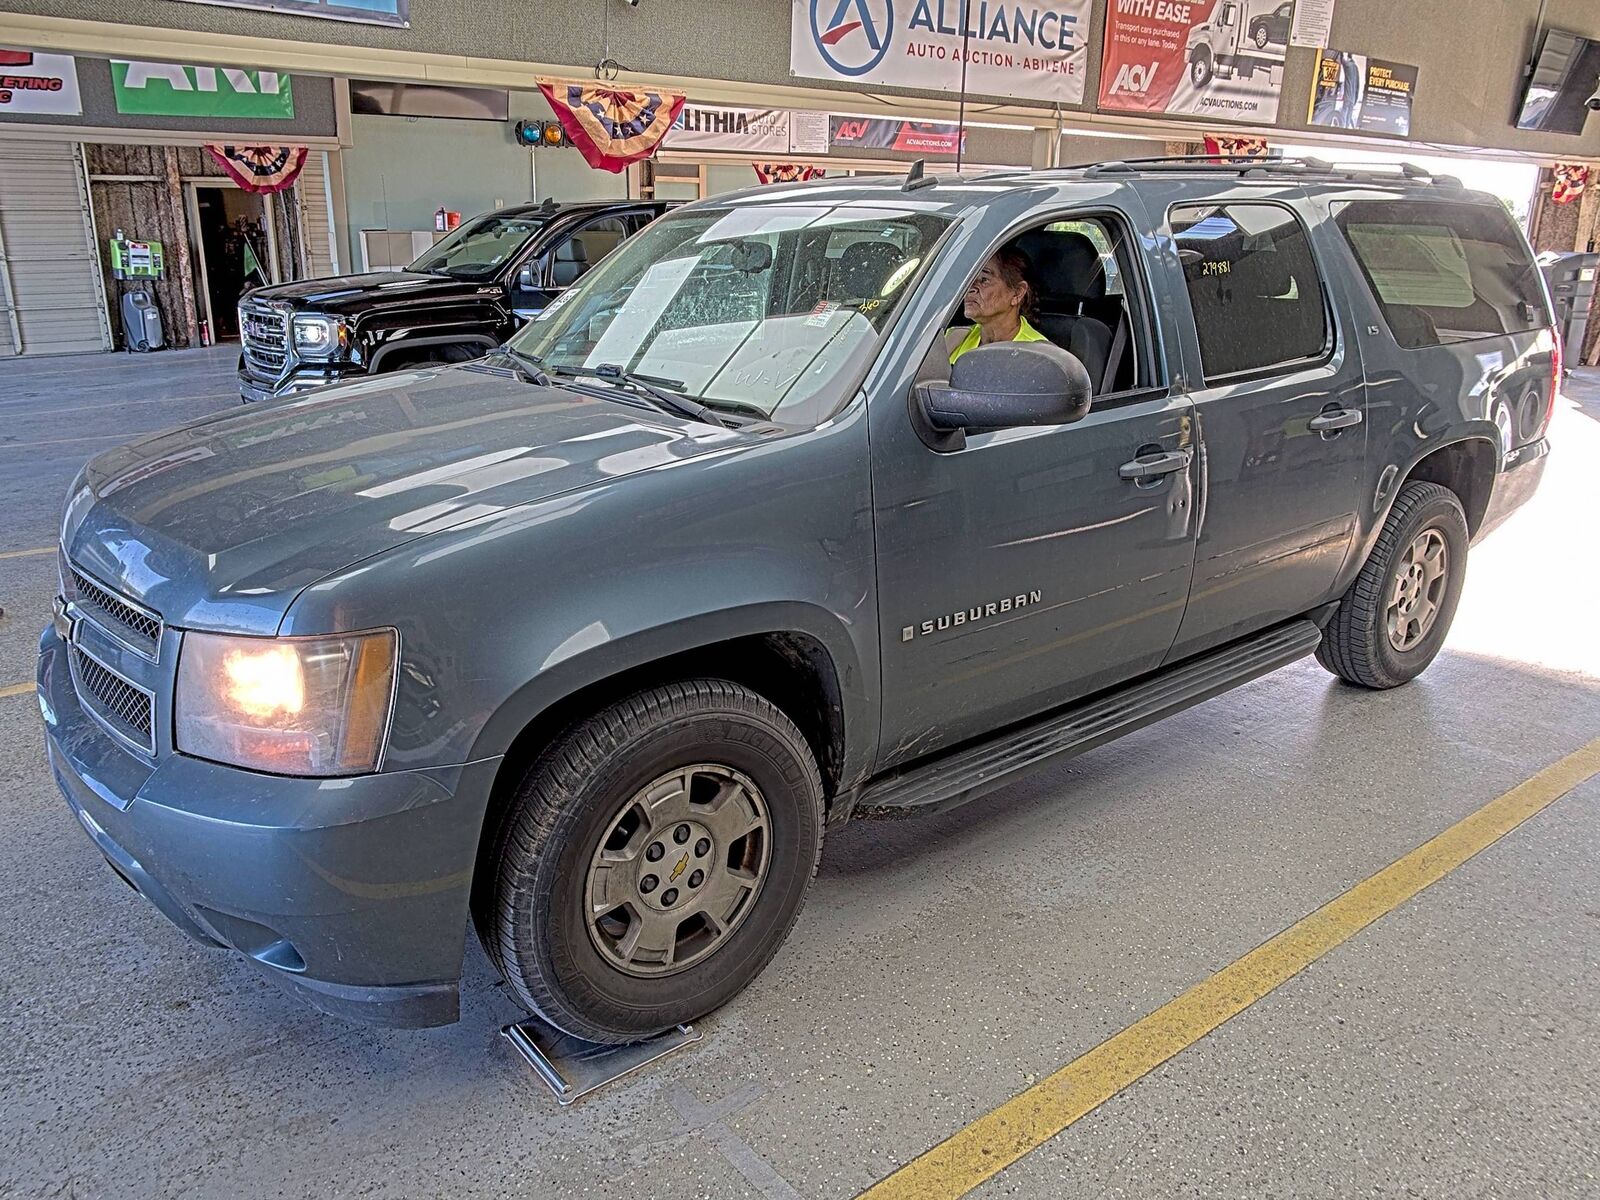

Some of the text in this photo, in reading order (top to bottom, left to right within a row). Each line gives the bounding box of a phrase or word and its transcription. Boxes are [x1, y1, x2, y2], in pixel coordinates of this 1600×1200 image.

[1117, 0, 1191, 24] WITH EASE.
[908, 0, 1078, 51] ALLIANCE
[1115, 20, 1180, 38] Transport cars purchased
[1114, 32, 1119, 40] in
[1120, 34, 1130, 42] this
[1137, 38, 1147, 47] any
[906, 43, 946, 57] AUTO
[952, 49, 1013, 67] AUCTION
[1023, 57, 1075, 75] ABILENE
[1108, 61, 1160, 95] ACV
[1370, 66, 1393, 78] PROTECT
[0, 75, 63, 91] ETING
[1368, 76, 1384, 87] EVERY
[1200, 98, 1258, 111] ACVAUCTIONS.COM
[684, 109, 776, 134] LITHIA AUTO
[835, 120, 869, 139] ACV
[751, 125, 787, 137] STORES
[906, 138, 952, 148] ACVAUCTIONS.COM
[1202, 260, 1231, 276] 279881
[1367, 325, 1380, 336] LS
[920, 589, 1042, 636] SUBURBAN
